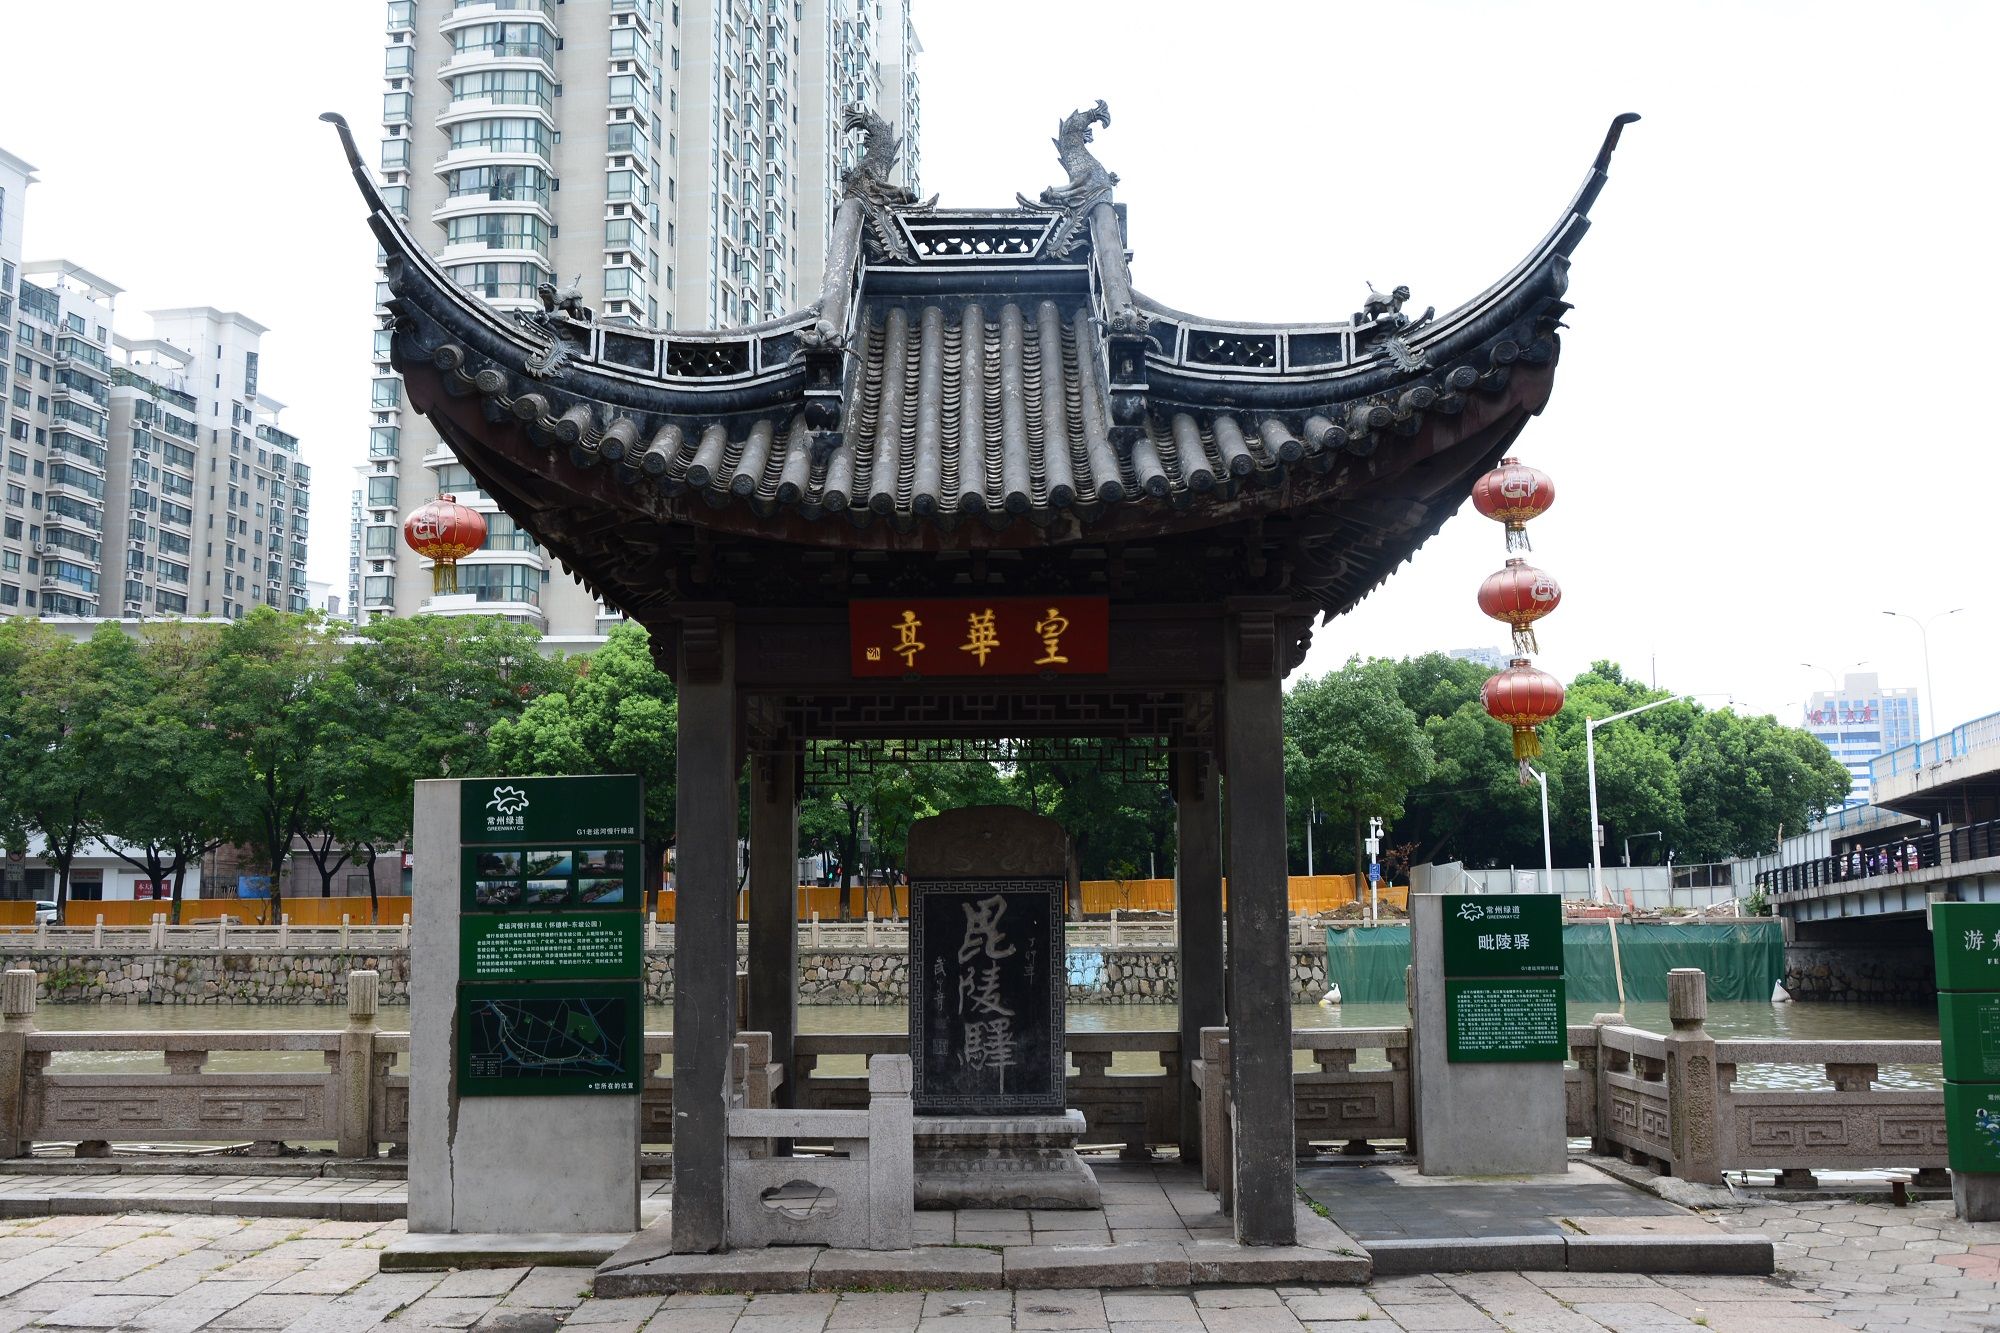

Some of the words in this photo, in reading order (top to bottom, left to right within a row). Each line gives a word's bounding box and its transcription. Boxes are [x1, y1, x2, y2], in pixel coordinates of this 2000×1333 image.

[487, 816, 524, 825] 常州绿道
[1485, 905, 1521, 914] 常州绿道
[594, 1082, 634, 1090] 您所在的位置
